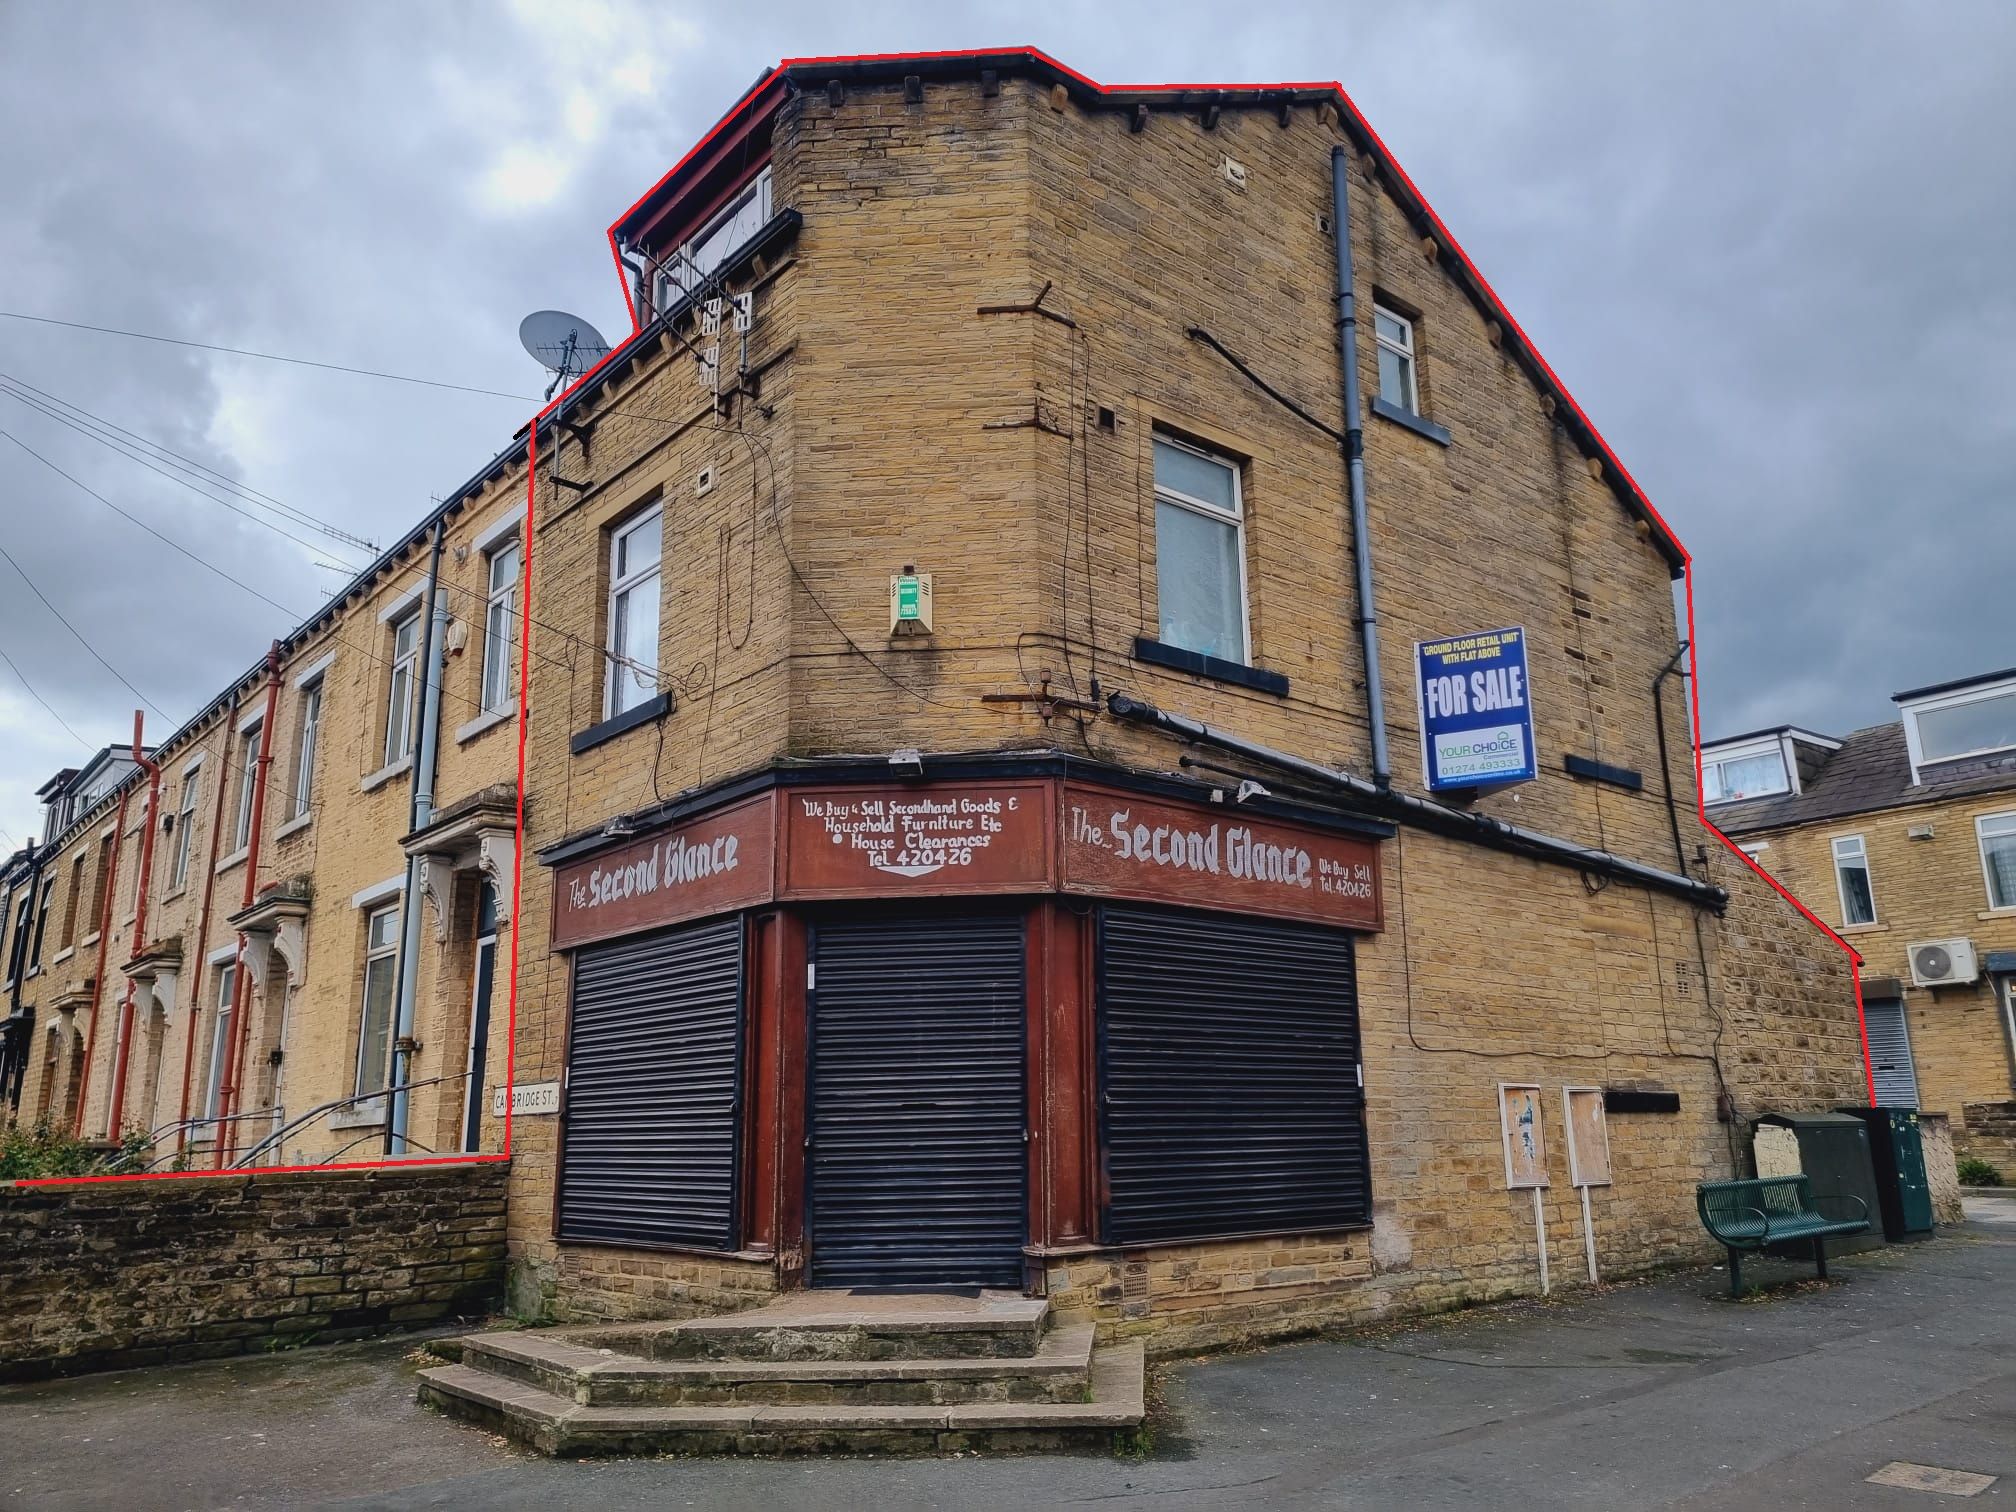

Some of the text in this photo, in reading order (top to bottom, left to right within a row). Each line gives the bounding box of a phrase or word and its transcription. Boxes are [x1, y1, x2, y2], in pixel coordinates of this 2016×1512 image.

[1453, 637, 1476, 652] FLOOR
[1477, 634, 1500, 649] RETAIL
[1442, 647, 1501, 665] WITH FLAT ABOVE
[1426, 665, 1524, 719] FOR SALE
[1439, 745, 1471, 759] YOUR
[1442, 758, 1521, 776] 01274 493333
[802, 798, 824, 817] We
[826, 801, 849, 819] Buy
[861, 800, 884, 816] Sell
[888, 798, 957, 815] Secondhand
[961, 797, 1002, 814] Goods
[824, 816, 895, 834] Household
[981, 814, 1002, 833] Etc
[851, 832, 992, 850] House Clearances
[1071, 806, 1312, 889] The Second Glance
[867, 847, 972, 867] Tel 420426
[569, 834, 738, 912] The Second Glance
[1319, 858, 1371, 882] We Buy Sell
[1336, 879, 1372, 898] 420426
[495, 1091, 540, 1109] CABRIDGE
